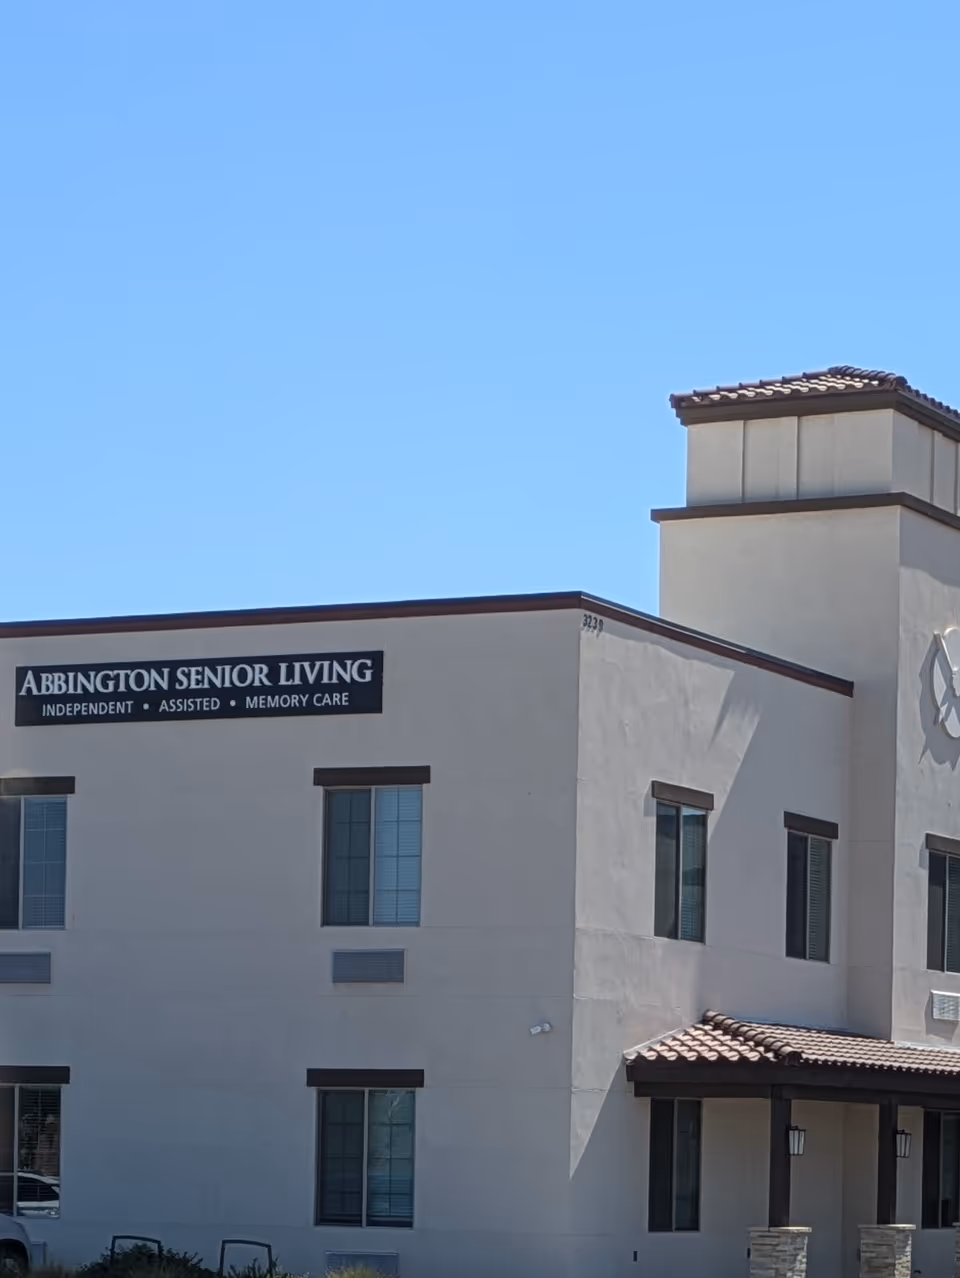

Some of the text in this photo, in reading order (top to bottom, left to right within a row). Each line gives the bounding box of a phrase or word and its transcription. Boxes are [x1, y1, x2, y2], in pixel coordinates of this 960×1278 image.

[18, 659, 374, 696] ABBINGTON SENIOR LIVING
[42, 692, 350, 717] INDEPENDENT ASSISTED MEMORY CARE
